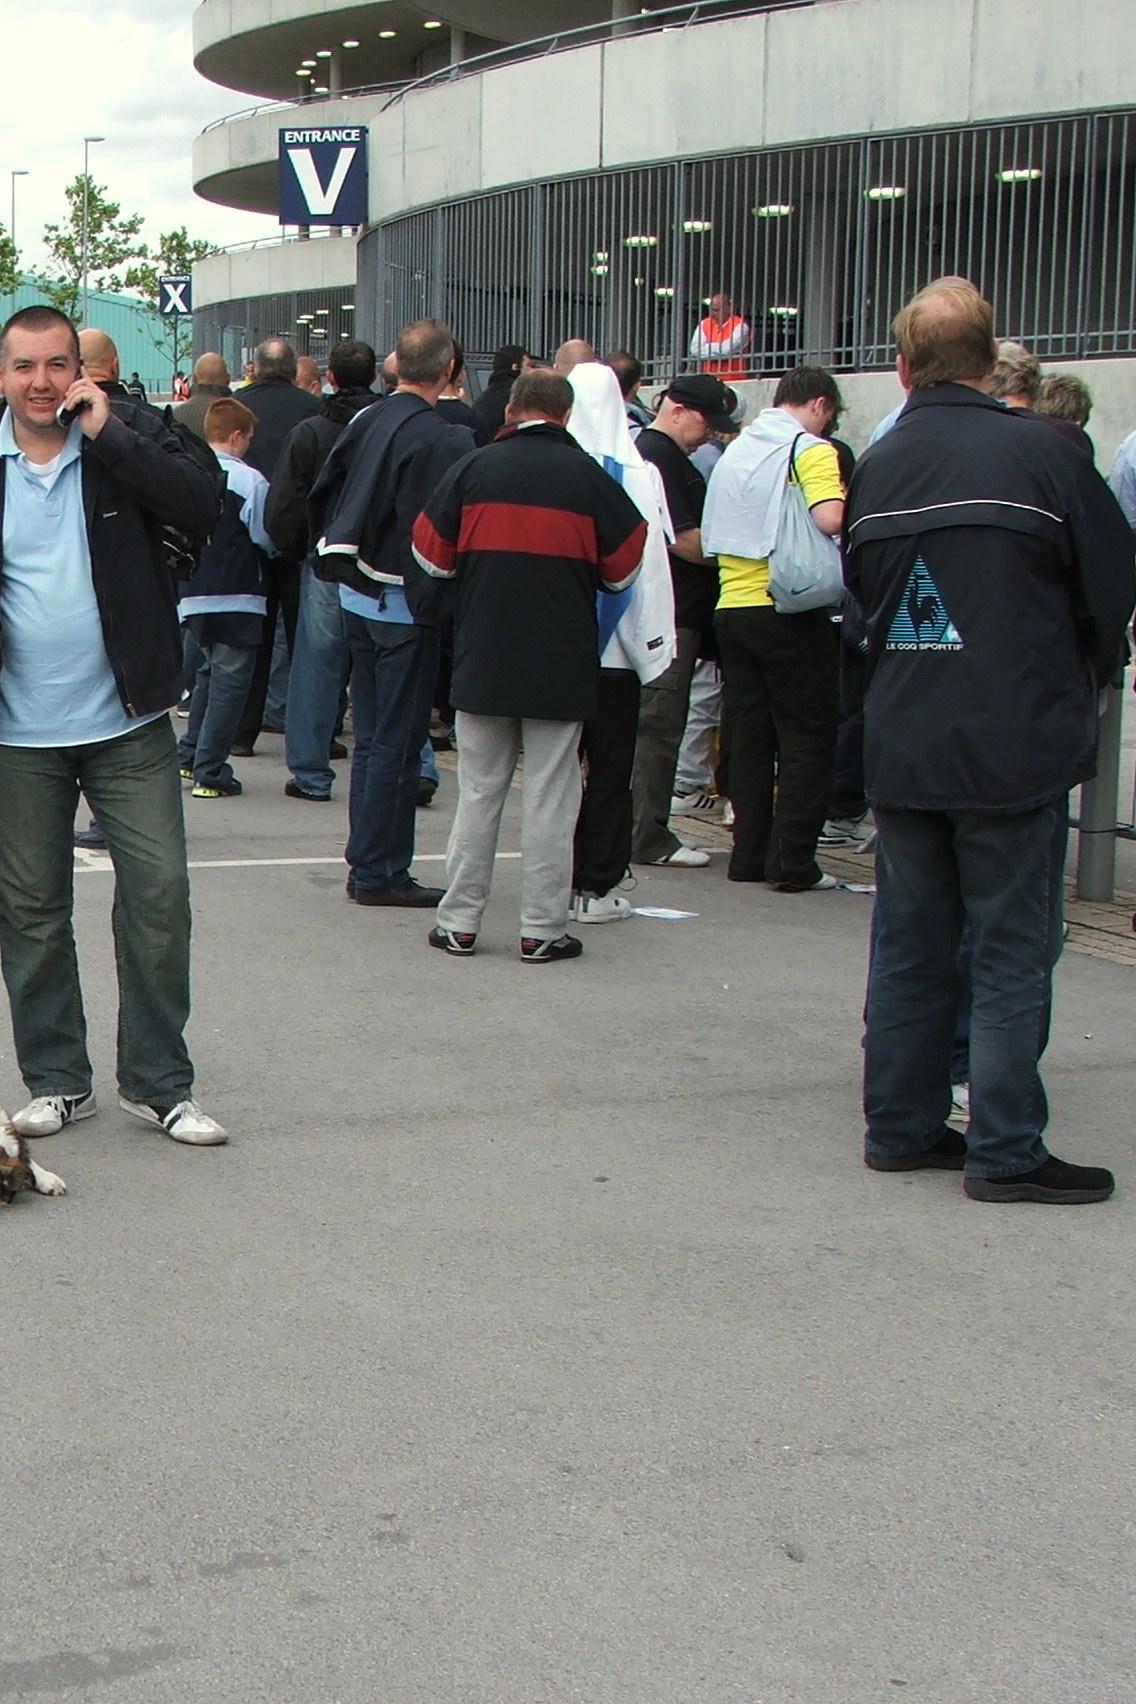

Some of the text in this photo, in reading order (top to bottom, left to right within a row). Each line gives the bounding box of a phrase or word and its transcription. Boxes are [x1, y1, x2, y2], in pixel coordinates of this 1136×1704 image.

[284, 129, 361, 144] ENTRANCE
[287, 147, 357, 216] V
[163, 283, 189, 313] X
[918, 643, 964, 651] SPORTIF
